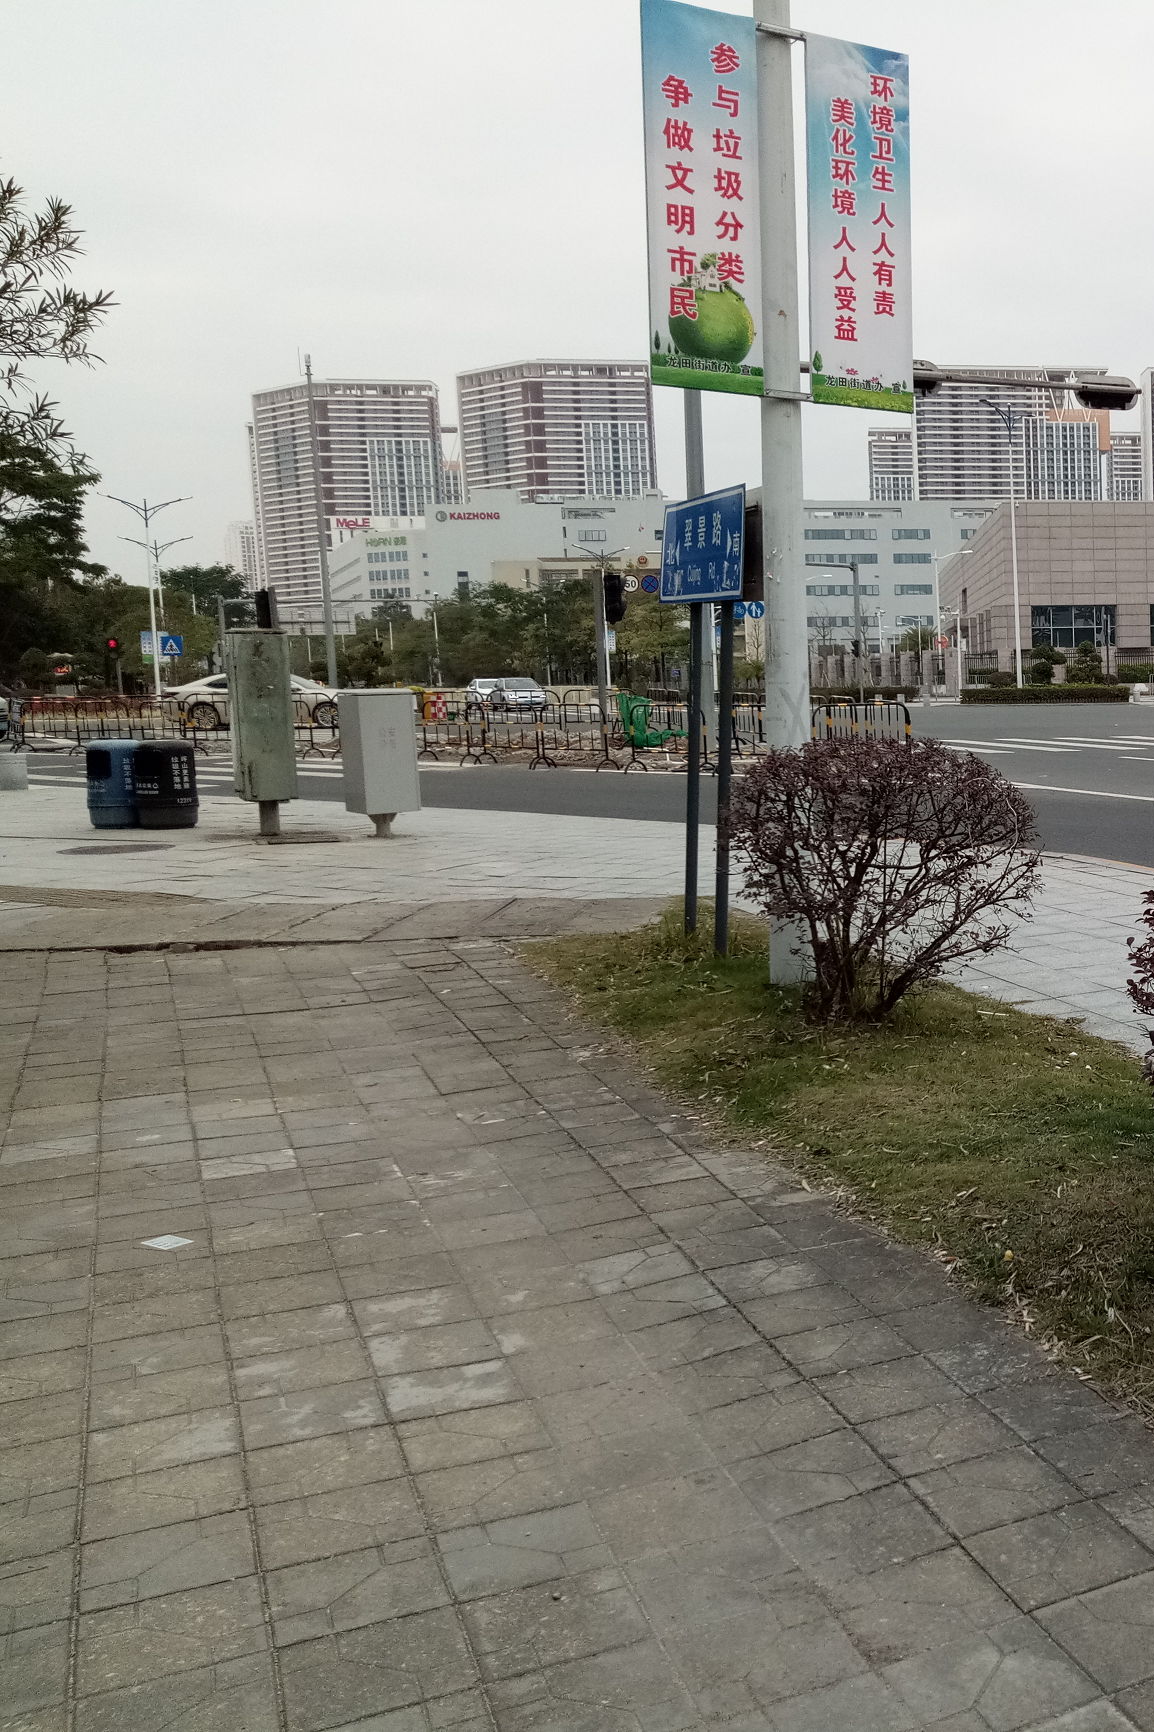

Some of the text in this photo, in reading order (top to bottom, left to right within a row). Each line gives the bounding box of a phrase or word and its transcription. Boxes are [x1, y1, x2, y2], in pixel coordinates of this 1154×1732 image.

[709, 42, 745, 285] 参与垃圾分类
[661, 74, 699, 321] 争做文明市民
[450, 512, 501, 520] KAIZHONG
[683, 510, 722, 552] 翠景路
[732, 530, 741, 557] 南
[665, 542, 675, 566] 北
[625, 579, 637, 589] 50
